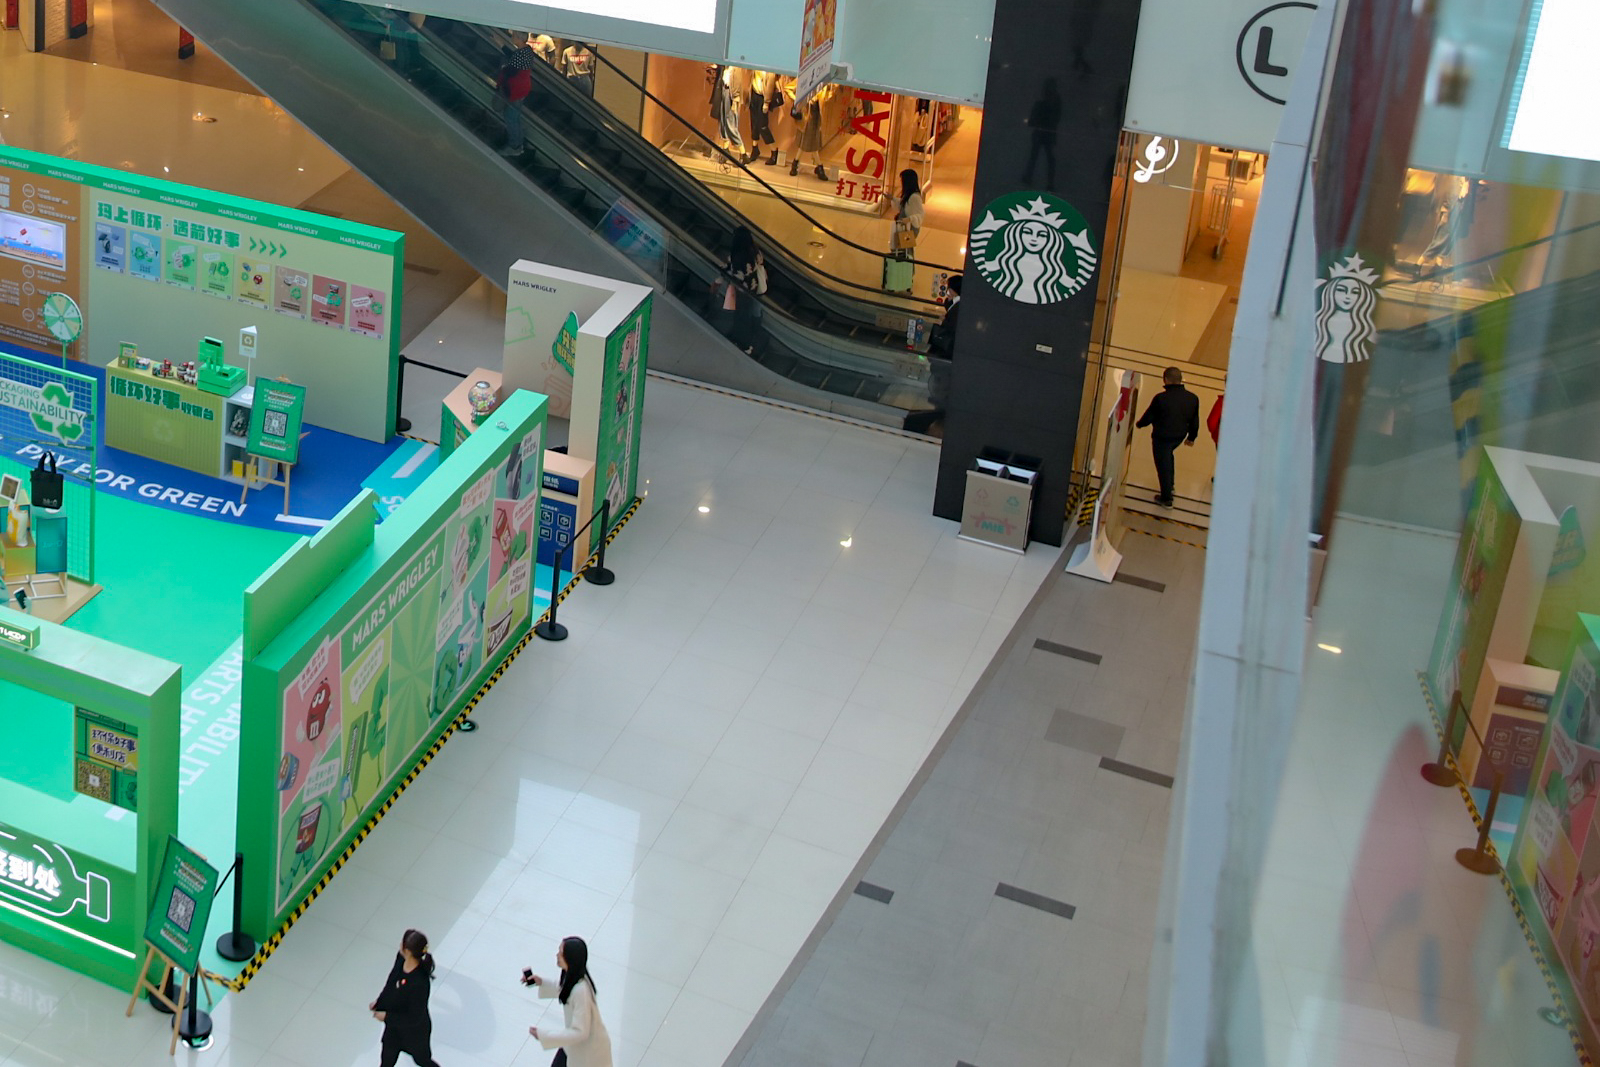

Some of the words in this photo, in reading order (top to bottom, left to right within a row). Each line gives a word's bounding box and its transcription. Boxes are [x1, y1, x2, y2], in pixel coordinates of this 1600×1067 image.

[1254, 25, 1289, 78] L
[846, 89, 893, 179] SAL
[47, 169, 62, 178] MARS
[62, 171, 84, 182] WRIGLEY
[102, 181, 118, 191] MARS
[118, 184, 141, 195] WRIGLEY
[835, 178, 882, 204] 打折
[159, 194, 176, 204] MARS
[175, 197, 198, 208] WRIGLEY
[218, 207, 233, 217] MARS
[233, 210, 257, 222] WRIGLEY
[277, 221, 294, 231] MARS
[293, 224, 319, 236] WRIGLEY
[339, 235, 356, 245] MARS
[356, 238, 382, 251] WRIGLEY
[110, 375, 180, 411] 循环好事
[16, 443, 76, 469] PAY
[72, 462, 136, 491] FOR
[138, 483, 248, 518] GREEN
[352, 601, 386, 651] MARS
[388, 543, 439, 610] WRIGLEY
[90, 742, 127, 764] 便利店
